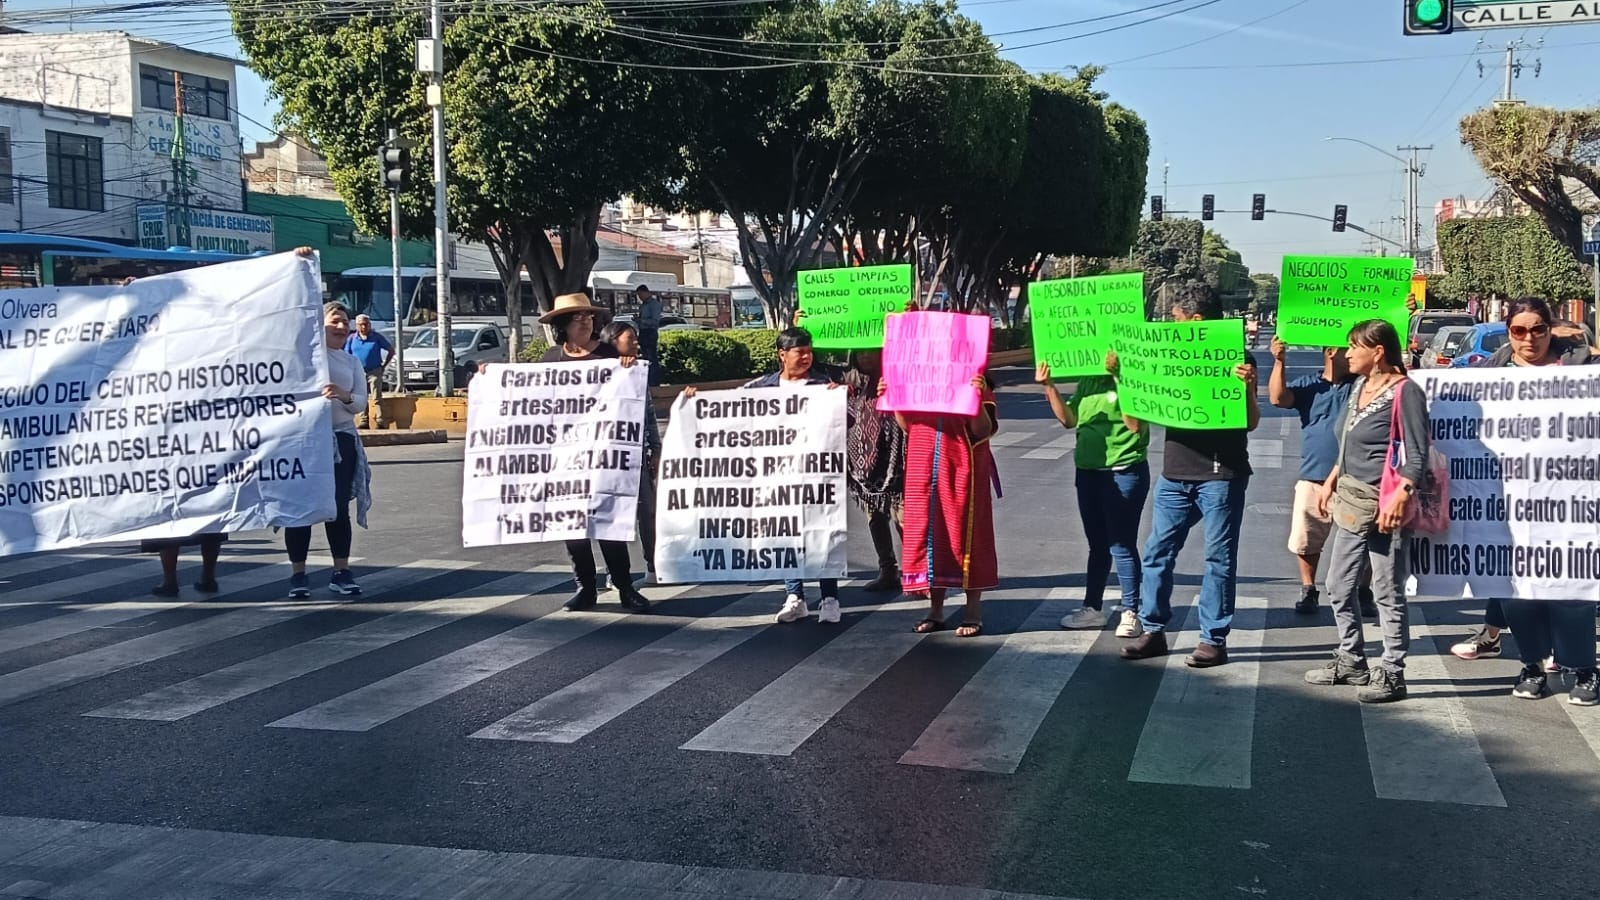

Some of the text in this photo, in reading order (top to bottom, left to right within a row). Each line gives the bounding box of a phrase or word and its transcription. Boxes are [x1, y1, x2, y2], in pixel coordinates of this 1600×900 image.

[1461, 5, 1552, 24] CALLE
[143, 220, 163, 237] CRUZ
[214, 214, 227, 229] DE
[804, 270, 898, 285] CALLES LIMPIAS
[1288, 261, 1412, 282] NEGOCIOS FORMALES
[804, 284, 910, 299] COMERCIO ORDENADO
[1043, 280, 1097, 299] DESORDEN
[1102, 280, 1141, 292] URBANO
[1297, 282, 1401, 297] PAGAN RENTA E
[1, 298, 58, 320] Olvera
[1048, 304, 1079, 319] AFECTA
[1085, 307, 1092, 316] A
[1096, 301, 1137, 316] TODOS
[1313, 297, 1380, 310] IMPUESTOS
[1112, 322, 1208, 343] AMBULANTAJE
[1286, 315, 1343, 328] JUGUEMOS
[24, 328, 51, 348] DE
[501, 365, 613, 389] Carritos de
[1122, 356, 1232, 378] CAOS Y DESORDEN
[54, 380, 91, 404] DEL
[96, 370, 172, 399] CENTRO
[177, 358, 285, 390] HISTÓRICO
[1118, 375, 1242, 401] RESPETEMOS LOS
[1425, 377, 1438, 401] El
[1439, 376, 1514, 402] comercio
[1, 393, 303, 440] AMBULANTES REVENDEDORES,
[695, 397, 780, 420] Carritos
[1132, 396, 1210, 425] ESPACIOS
[469, 423, 557, 449] EXIGIMOS
[1497, 413, 1542, 442] exige
[1547, 412, 1564, 439] al
[108, 434, 196, 463] DESLEAL
[200, 430, 227, 454] AL
[232, 427, 262, 451] NO
[175, 463, 218, 490] QUE
[661, 456, 758, 480] EXIGIMOS
[1450, 453, 1530, 483] municipal
[1532, 457, 1543, 482] y
[667, 488, 689, 511] AL
[1486, 494, 1510, 521] del
[1515, 495, 1566, 523] centro
[699, 516, 801, 539] INFORMAL
[1409, 537, 1430, 576] NO
[1434, 541, 1470, 576] mas
[1474, 540, 1563, 579] comercio
